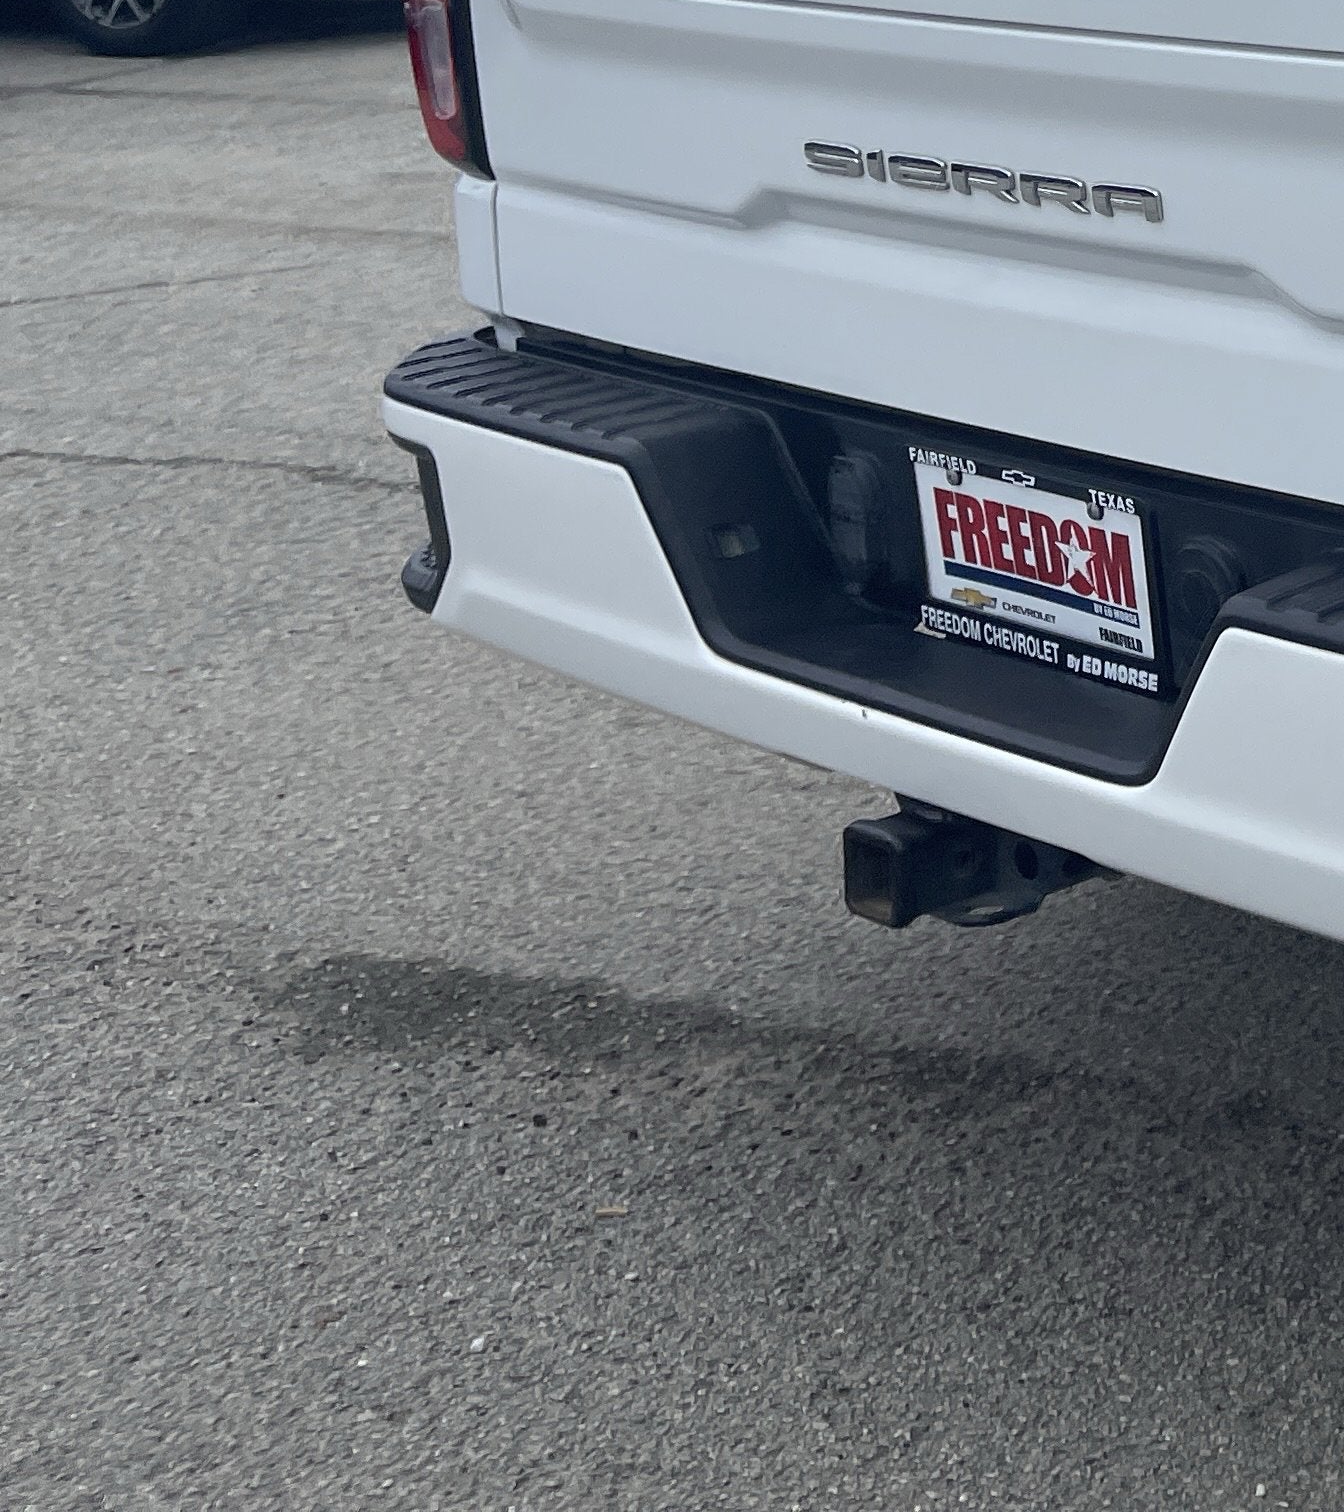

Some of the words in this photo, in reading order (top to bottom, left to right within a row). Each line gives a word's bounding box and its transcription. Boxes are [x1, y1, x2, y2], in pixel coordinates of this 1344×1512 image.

[803, 139, 1165, 224] SIERRA
[909, 446, 977, 475] FAIRFIELD
[1088, 489, 1136, 514] TEXAS
[933, 487, 1138, 610] FREEDOM
[920, 605, 982, 642] FREEDOM
[983, 622, 1060, 665] CHEVROLET
[1082, 655, 1102, 676] ED
[1103, 660, 1159, 692] MORSE
[1002, 601, 1056, 624] CHEVROLET
